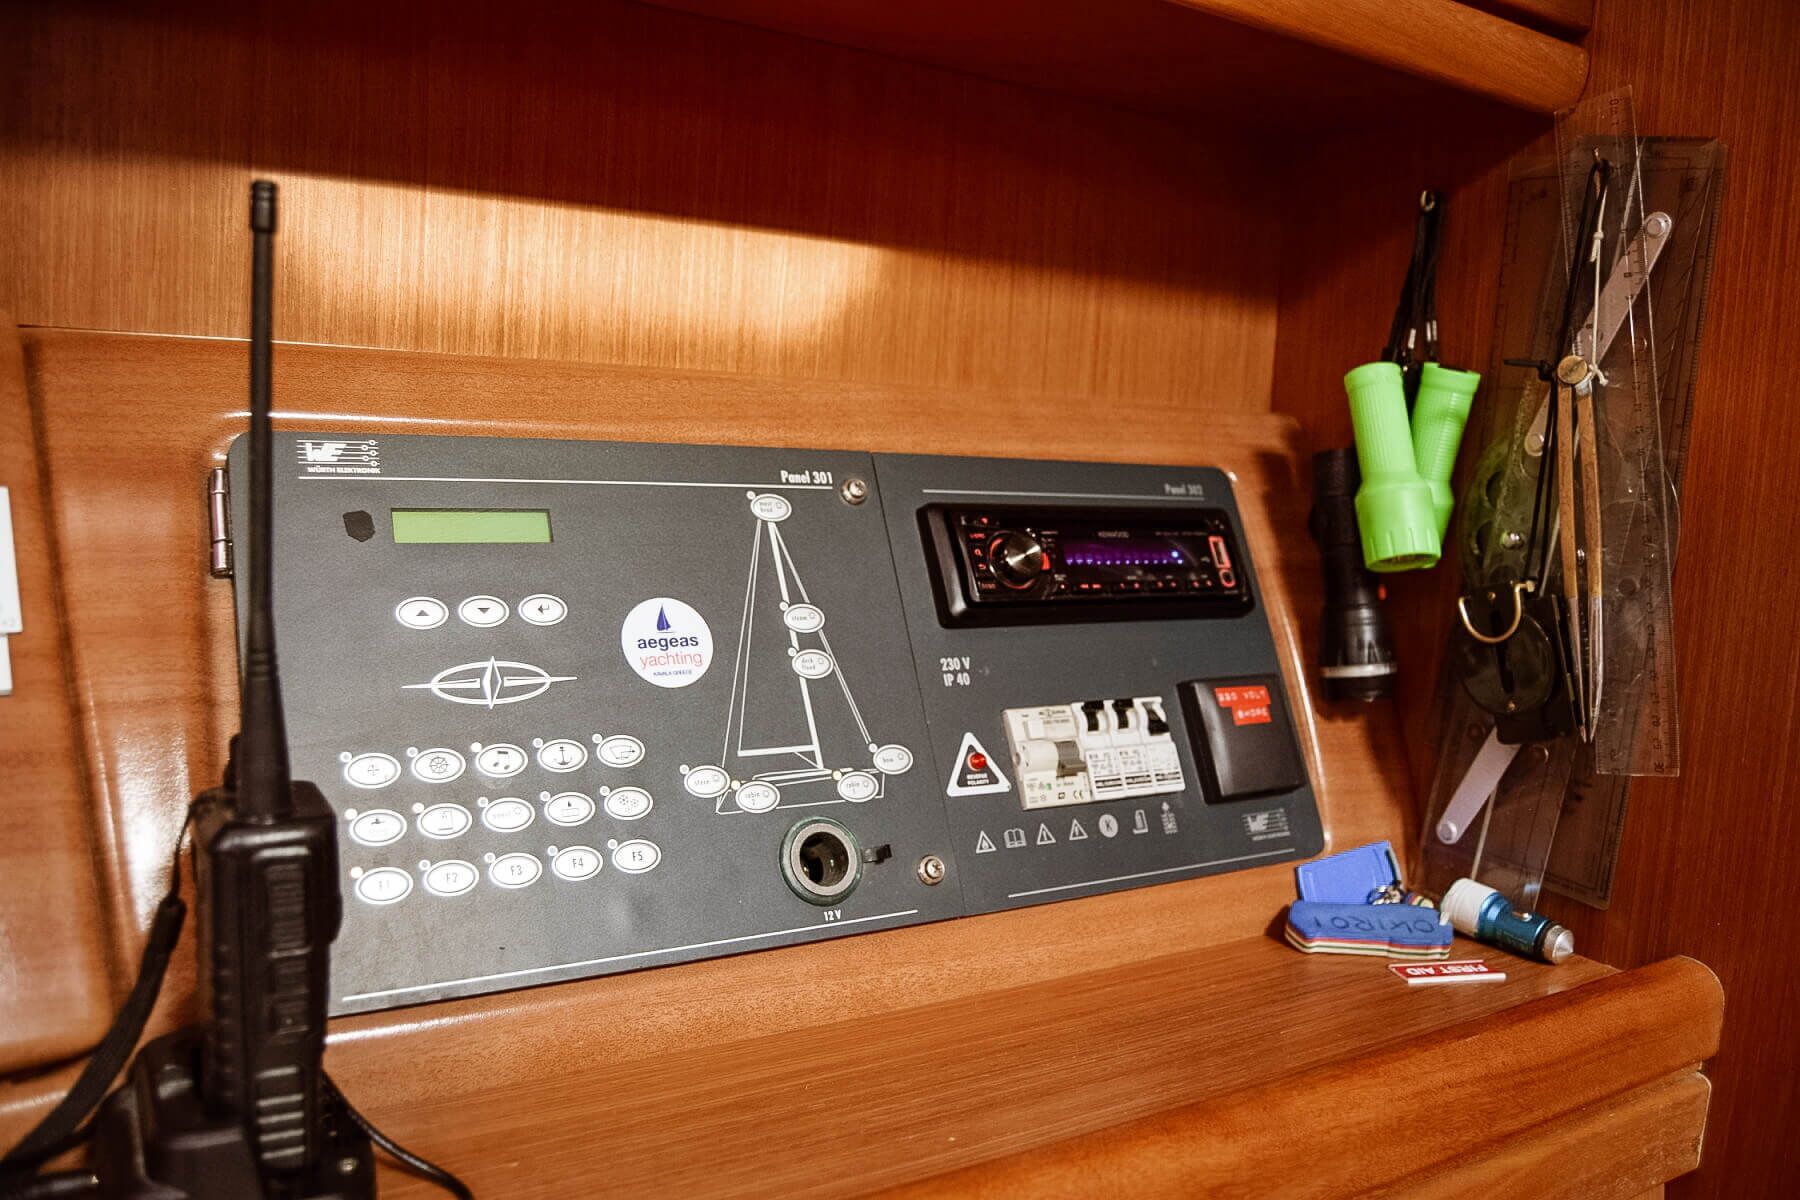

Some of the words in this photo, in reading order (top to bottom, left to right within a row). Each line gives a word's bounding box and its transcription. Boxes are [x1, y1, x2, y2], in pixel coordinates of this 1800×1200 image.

[780, 469, 811, 484] Panel
[812, 471, 833, 485] 301
[1164, 483, 1186, 495] Panel
[637, 634, 700, 651] aegeas
[639, 651, 704, 669] yachting
[940, 657, 960, 671] 230
[961, 656, 971, 670] V
[943, 673, 955, 687] IP
[956, 672, 971, 686] 40
[631, 850, 644, 862] F5
[572, 857, 585, 869] F4
[510, 864, 523, 876] F3
[445, 872, 459, 884] F2
[824, 910, 834, 921] 12
[835, 909, 842, 920] V
[1405, 965, 1436, 976] AID
[1439, 963, 1489, 975] FIRST
